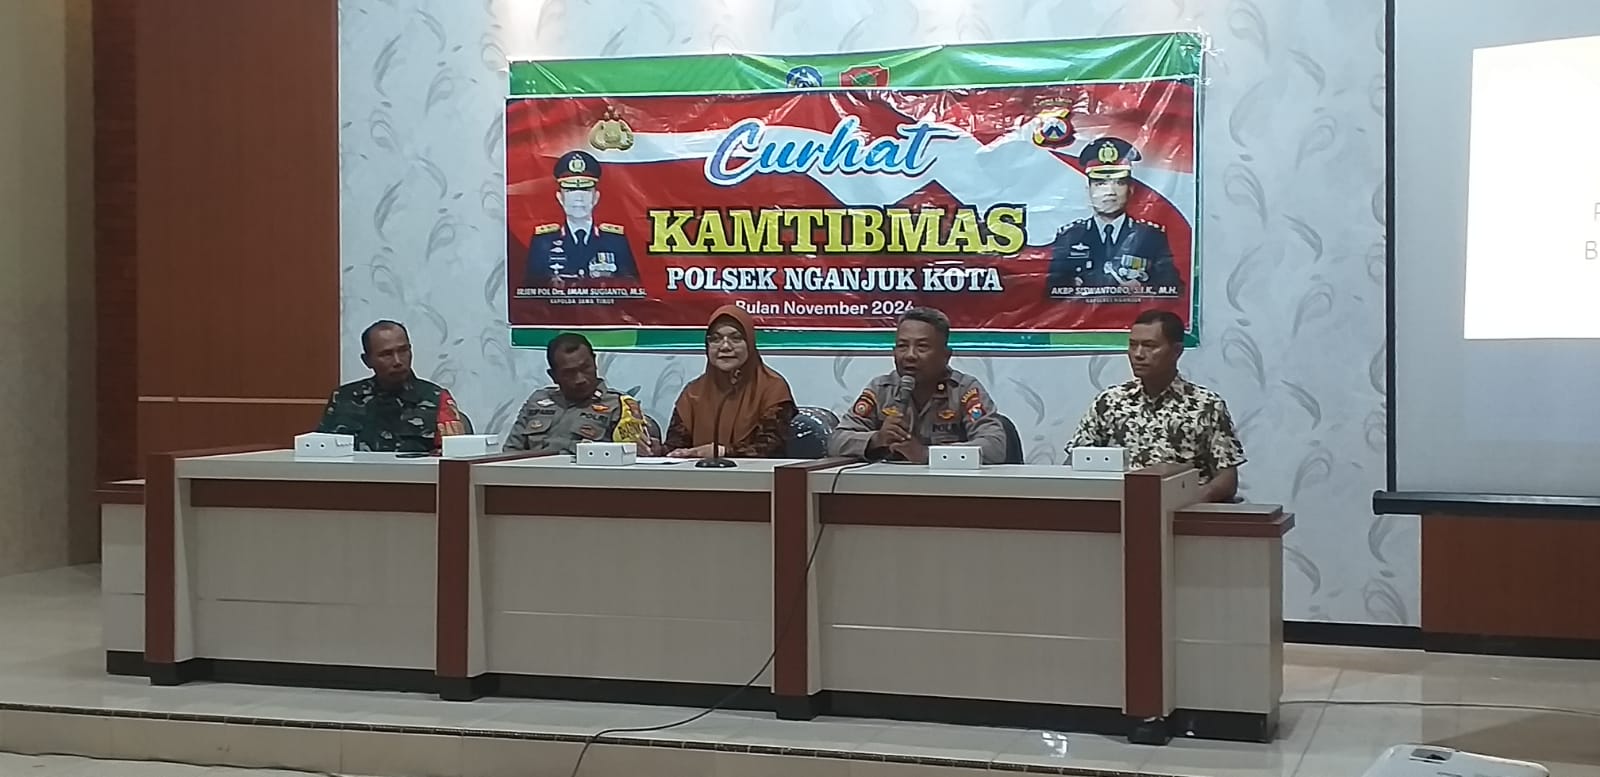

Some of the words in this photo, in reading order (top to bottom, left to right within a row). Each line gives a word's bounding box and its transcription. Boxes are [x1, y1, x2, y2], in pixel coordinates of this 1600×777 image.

[706, 117, 960, 184] Curhat
[648, 206, 1026, 254] KAMTIBMAS
[666, 267, 778, 291] POLSEK
[783, 267, 917, 291] NGANJUK
[922, 267, 1003, 291] KOTA
[783, 300, 868, 315] November
